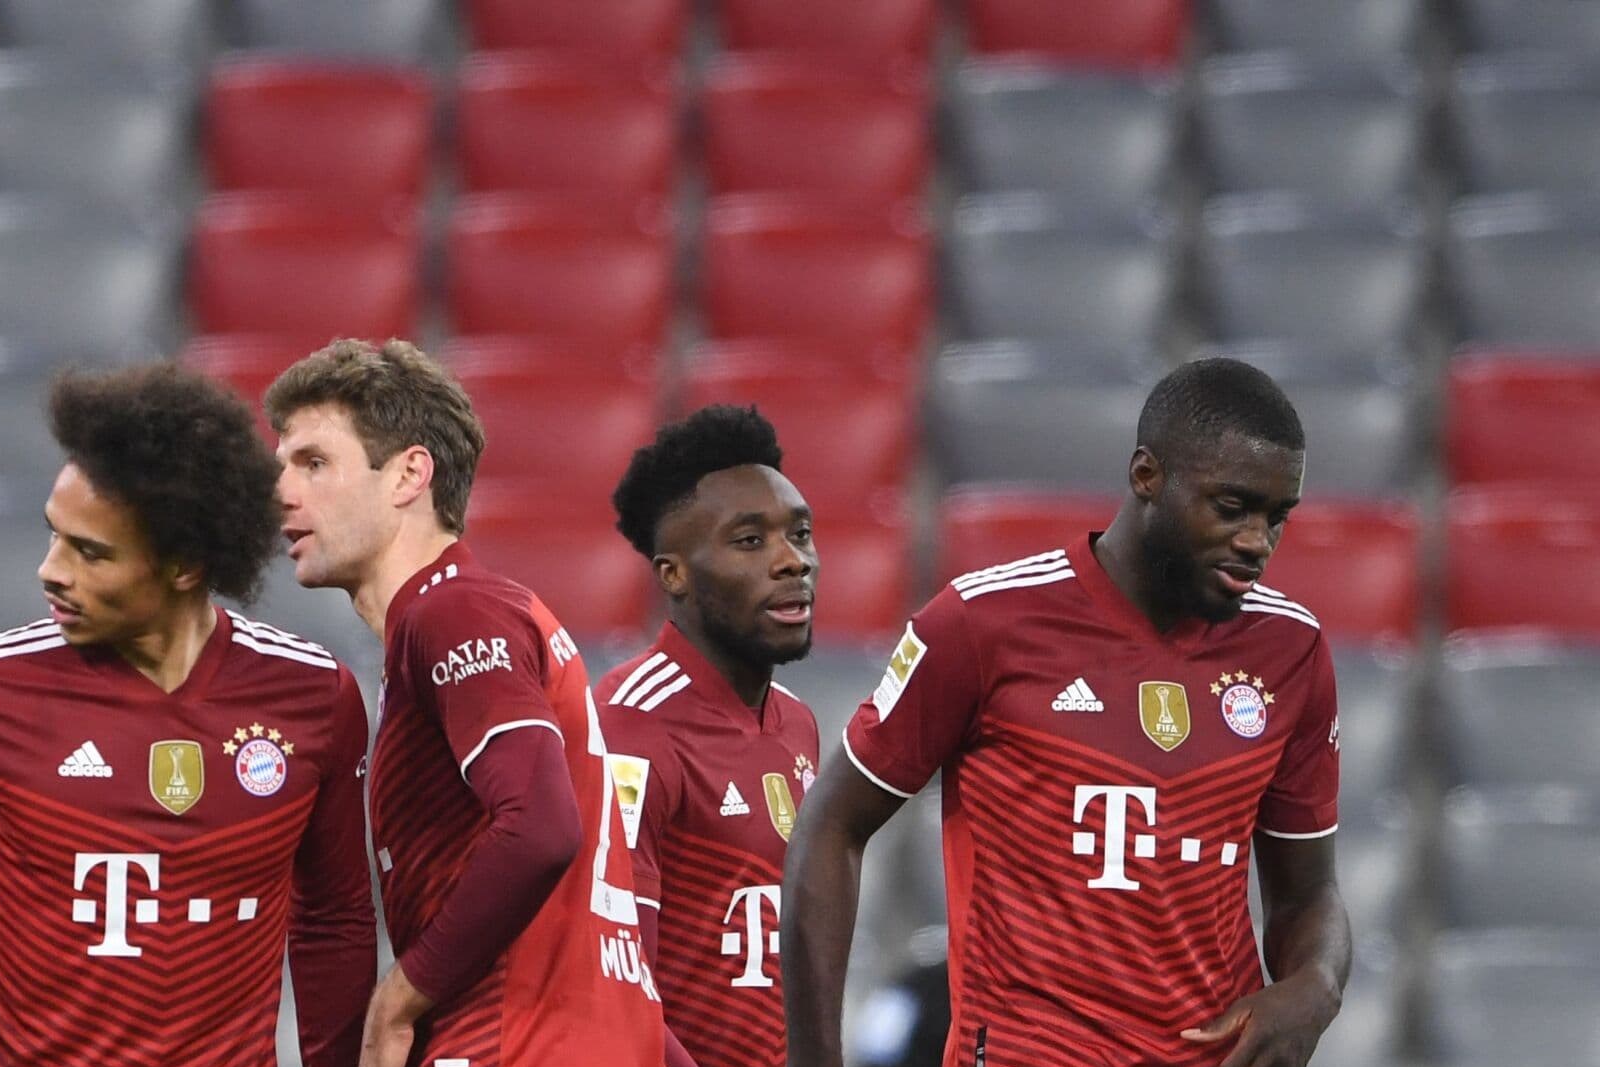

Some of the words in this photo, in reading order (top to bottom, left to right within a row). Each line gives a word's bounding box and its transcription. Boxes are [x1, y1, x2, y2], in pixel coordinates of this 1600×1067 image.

[432, 637, 510, 686] QATAR
[454, 656, 512, 686] AIRWAS
[1052, 698, 1105, 712] adidas
[1156, 722, 1178, 733] FIFA
[58, 764, 113, 778] adidas
[166, 786, 189, 796] FIFA
[1074, 785, 1157, 890] T
[73, 853, 160, 957] T
